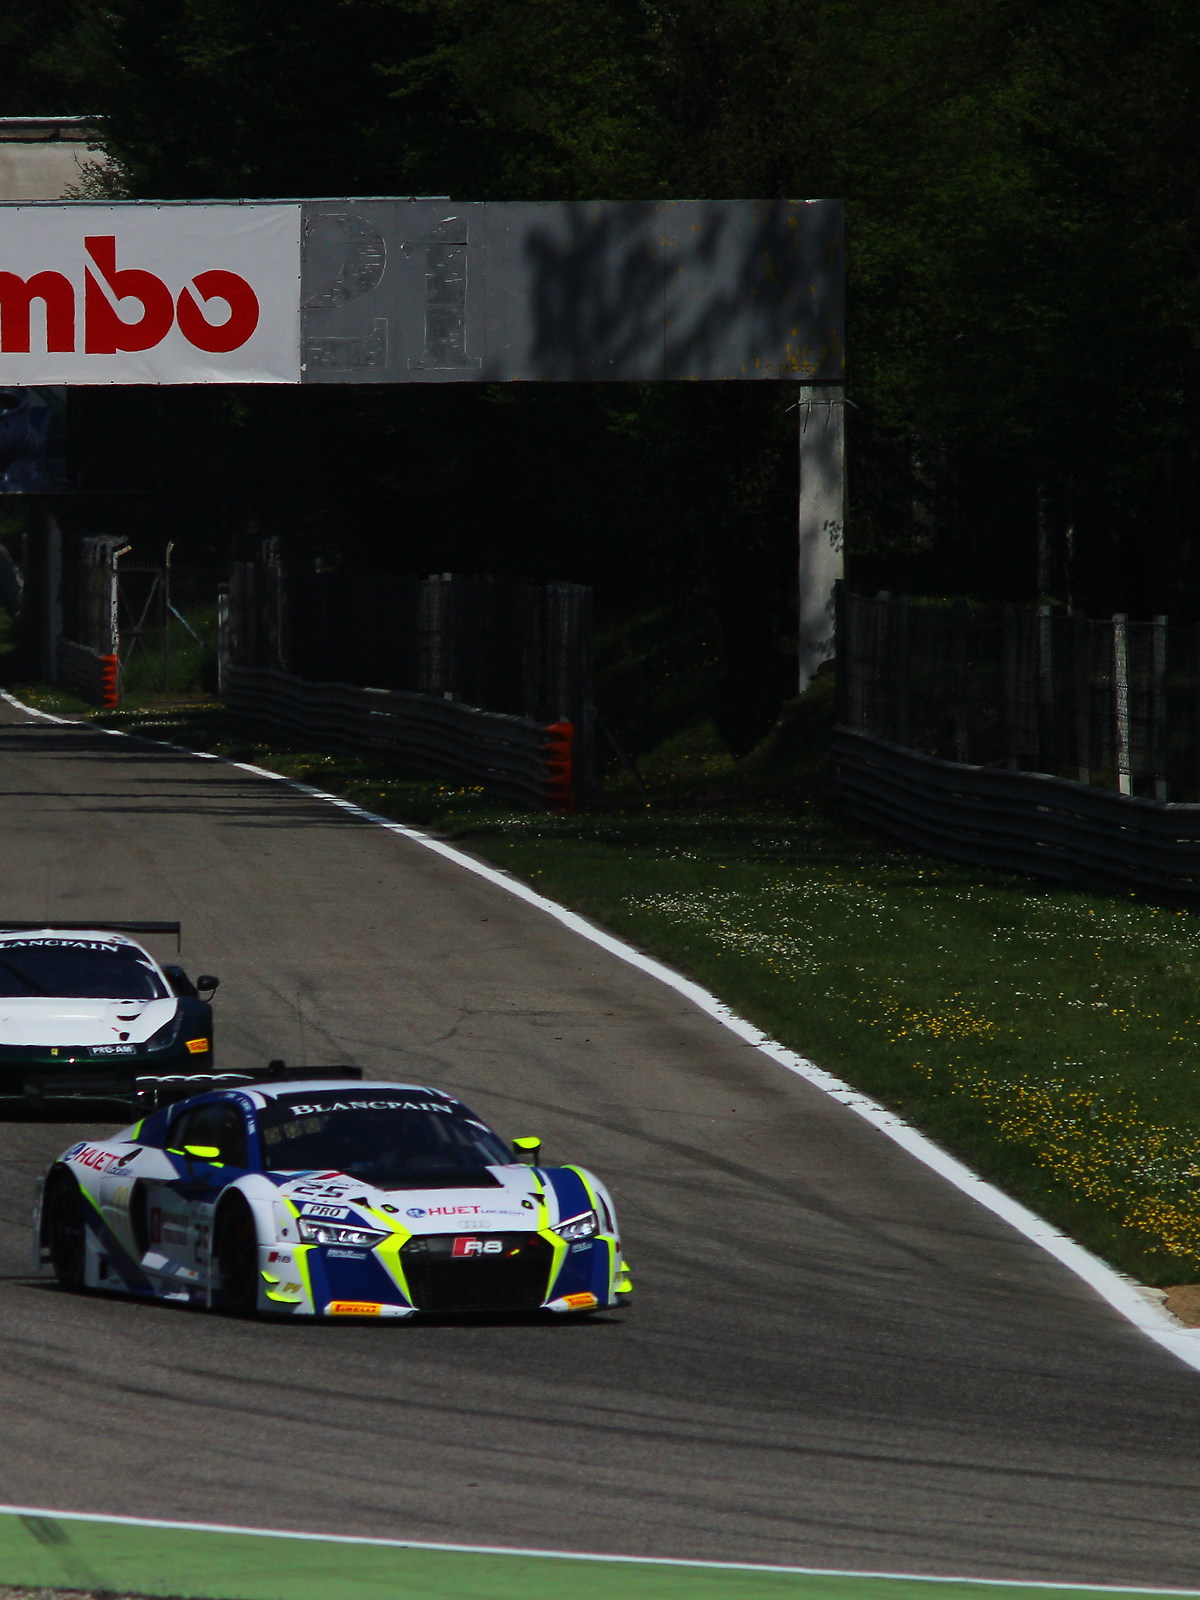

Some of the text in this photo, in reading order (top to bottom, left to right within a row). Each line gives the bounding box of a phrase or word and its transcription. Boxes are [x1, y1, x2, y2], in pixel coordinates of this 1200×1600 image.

[289, 1100, 454, 1116] BLANCPAIN
[75, 1147, 120, 1172] HUET
[293, 1182, 350, 1198] 25
[309, 1205, 341, 1217] PRO
[428, 1206, 481, 1216] HUET
[460, 1239, 503, 1255] R8
